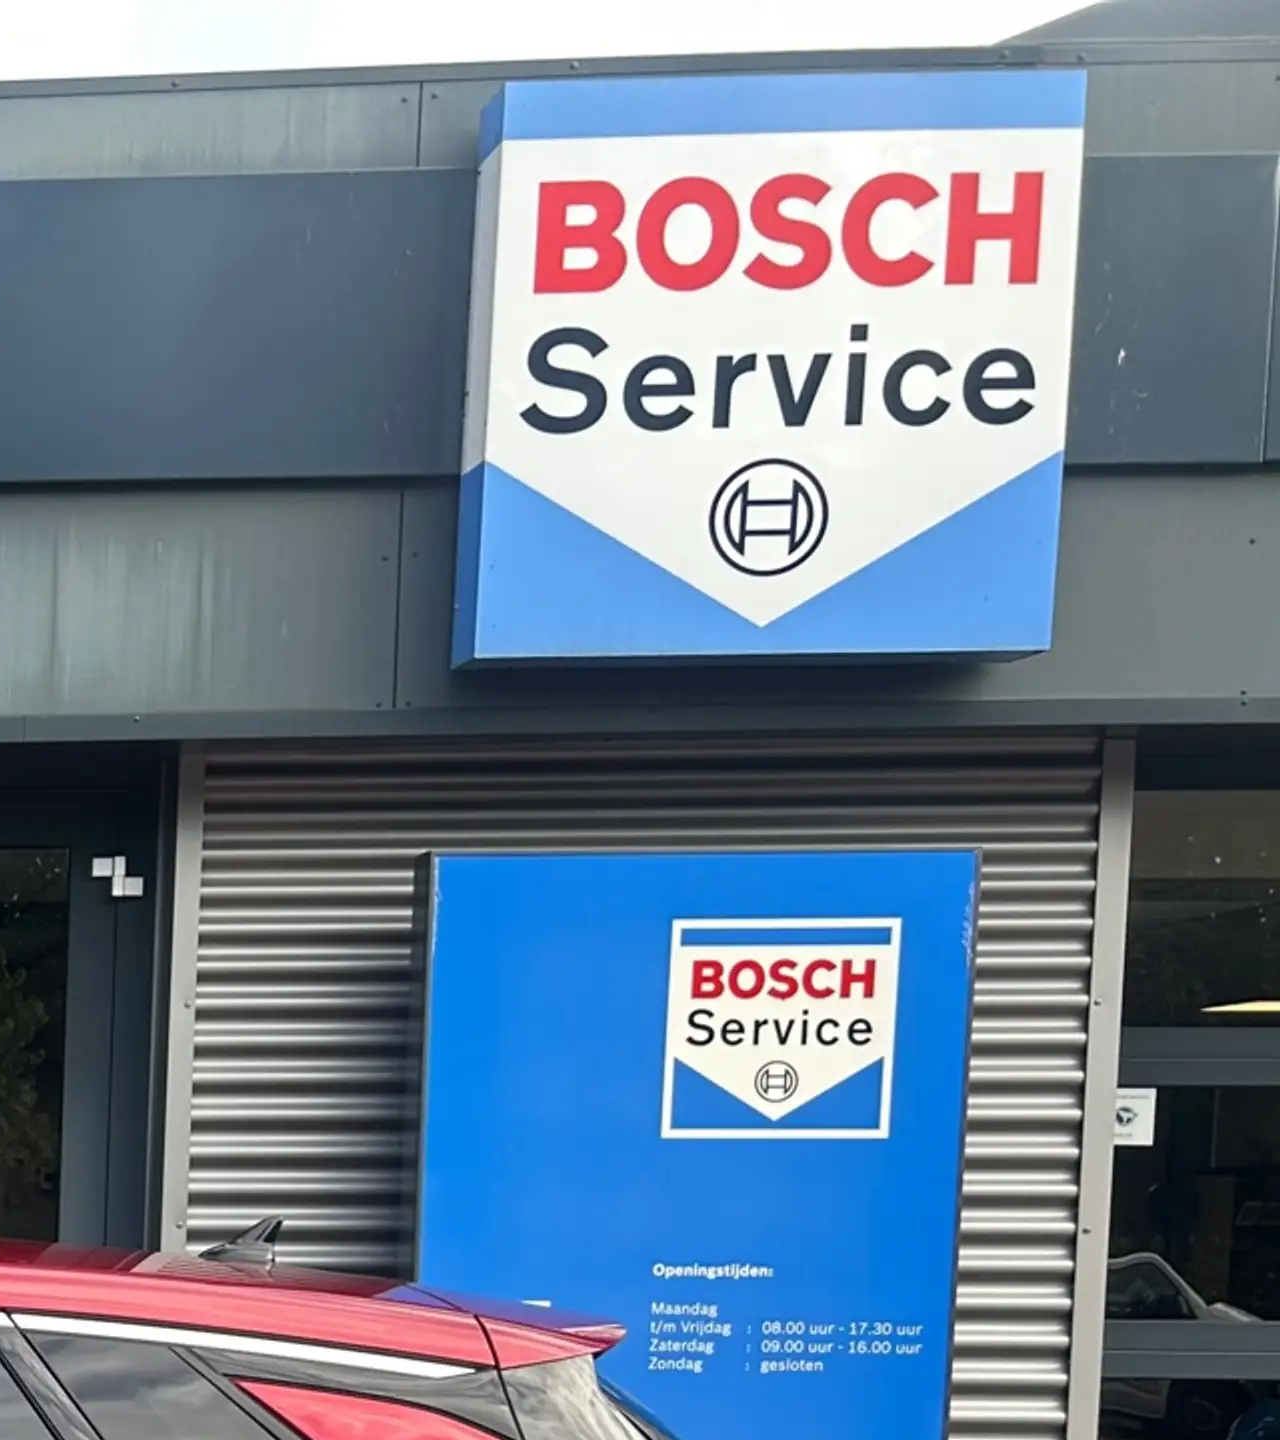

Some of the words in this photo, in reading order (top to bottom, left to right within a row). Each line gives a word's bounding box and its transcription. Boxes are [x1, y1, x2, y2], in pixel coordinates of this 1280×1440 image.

[533, 171, 1044, 294] BOSCH
[519, 323, 1037, 435] Service
[690, 959, 877, 1000] BOSCH
[685, 1008, 873, 1046] Service
[652, 1263, 774, 1279] Openingstijden:
[651, 1302, 718, 1317] Maandag
[650, 1320, 676, 1335] t/m
[682, 1320, 732, 1336] Vrijdag
[761, 1321, 805, 1335] 08.00
[809, 1324, 835, 1335] uur
[848, 1322, 892, 1336] 17.30
[896, 1324, 923, 1336] uur
[649, 1338, 714, 1354] Zaterdag
[760, 1340, 804, 1354] 09.00
[808, 1343, 834, 1354] uur
[848, 1340, 891, 1354] 16.00
[895, 1343, 922, 1354] uur
[648, 1356, 703, 1373] Zondag
[760, 1358, 824, 1373] gesloten
